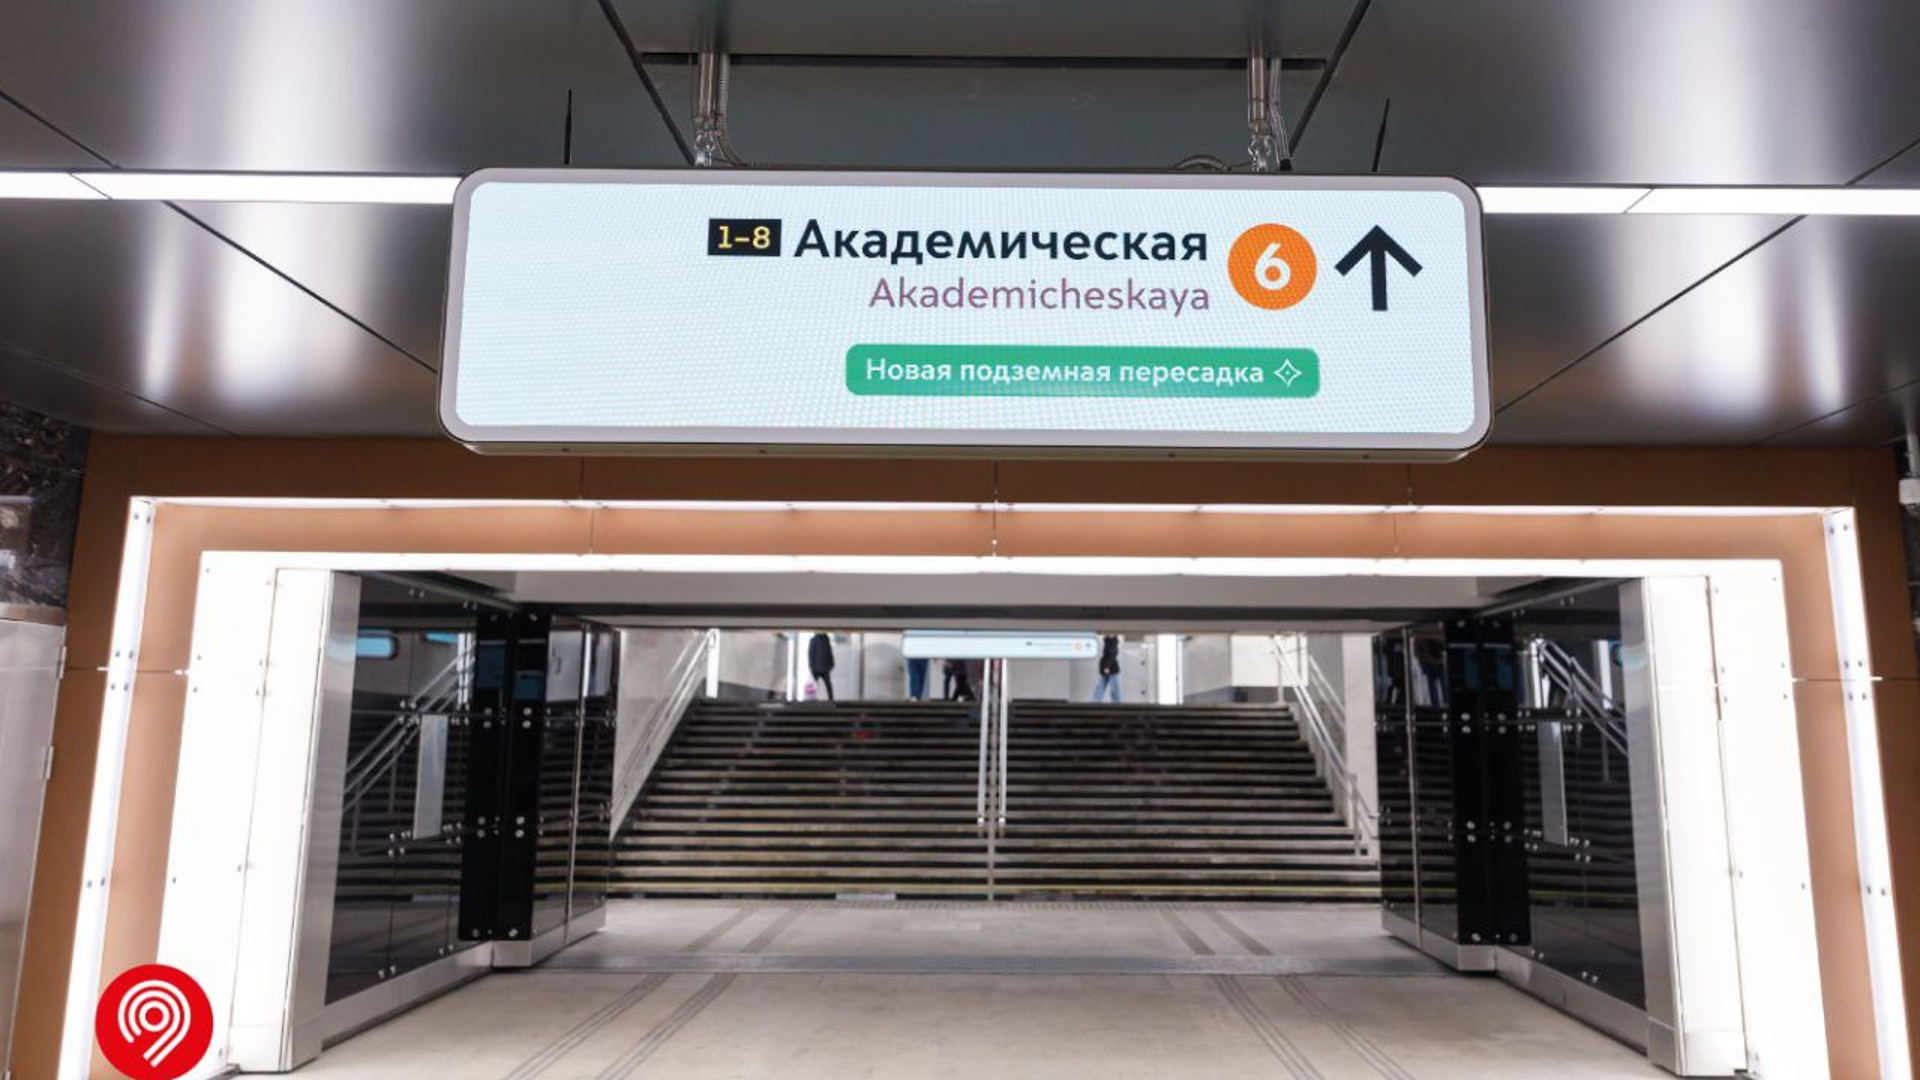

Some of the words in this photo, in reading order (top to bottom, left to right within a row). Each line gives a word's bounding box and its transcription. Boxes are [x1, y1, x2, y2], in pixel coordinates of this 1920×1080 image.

[793, 218, 1208, 265] Академическая
[1254, 242, 1292, 291] 6
[868, 276, 1210, 318] Akademicheskaya
[866, 358, 953, 381] Новая
[960, 363, 1111, 385] подземная
[1119, 364, 1265, 388] пересадка
